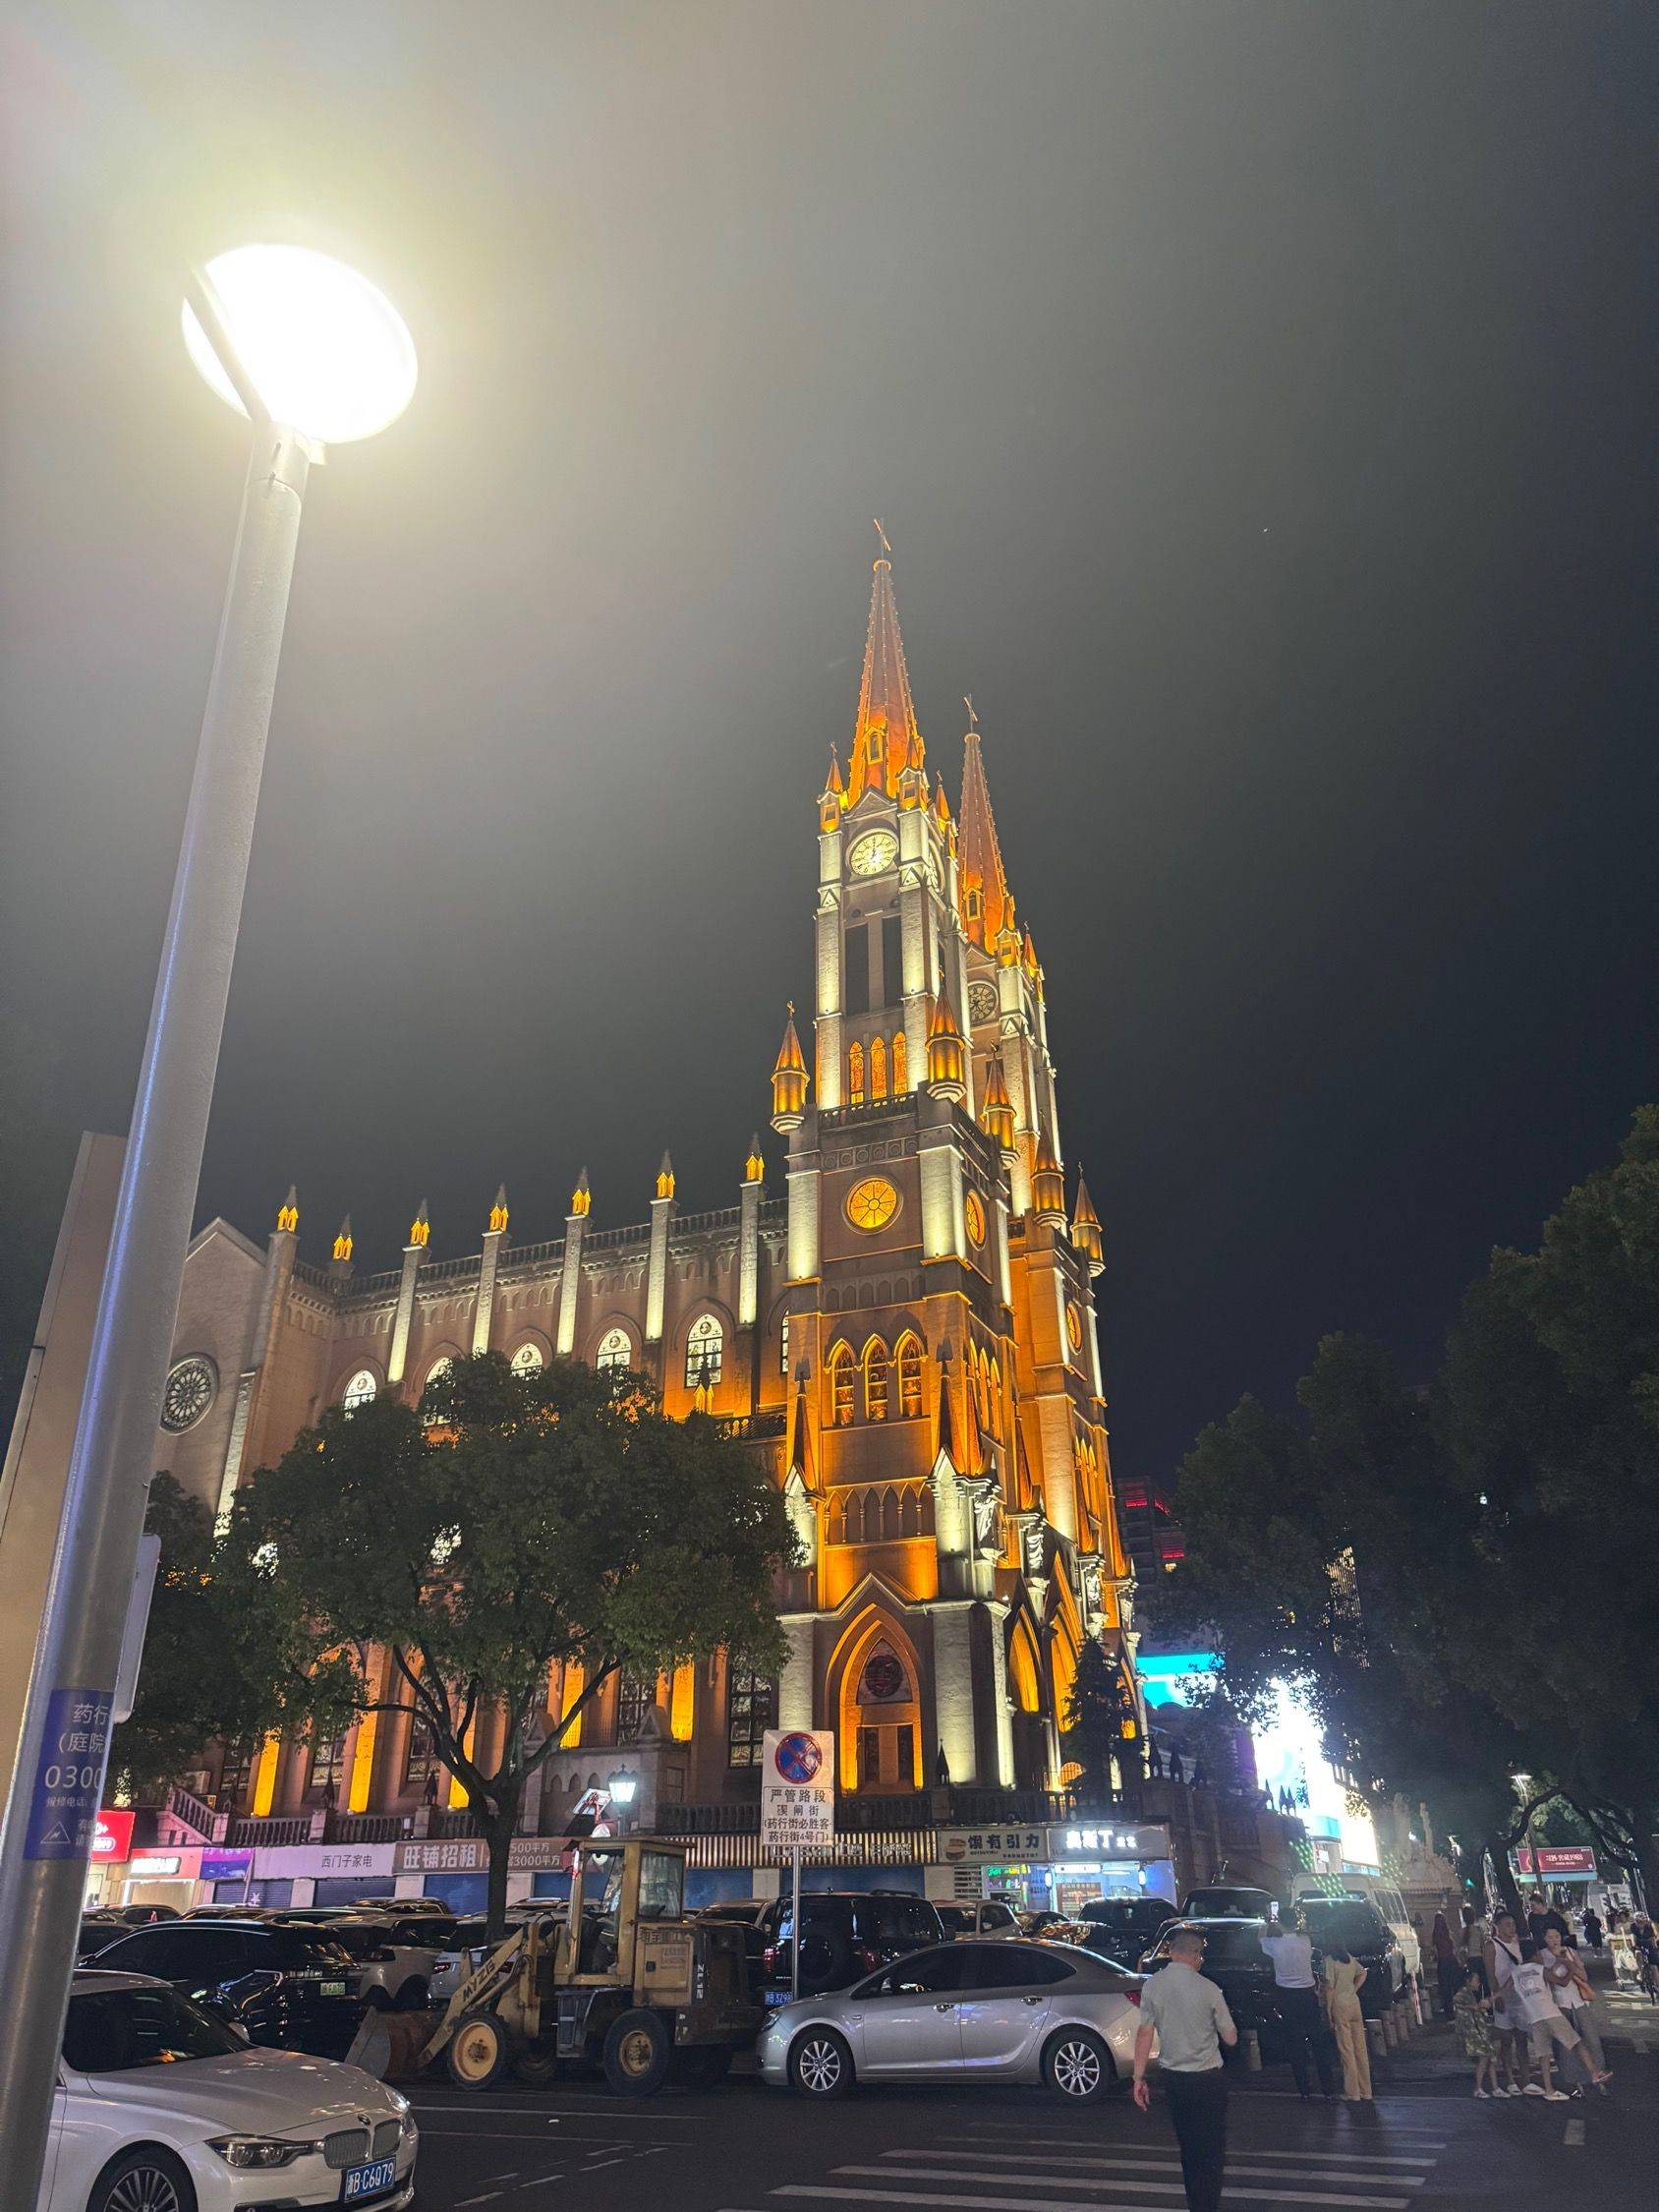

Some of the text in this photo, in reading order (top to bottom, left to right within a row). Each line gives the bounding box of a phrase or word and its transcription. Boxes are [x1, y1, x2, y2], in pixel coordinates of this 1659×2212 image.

[771, 1789, 826, 1803] 严管路段
[321, 1854, 372, 1868] 西门子家电
[403, 1844, 477, 1869] 旺铺招租
